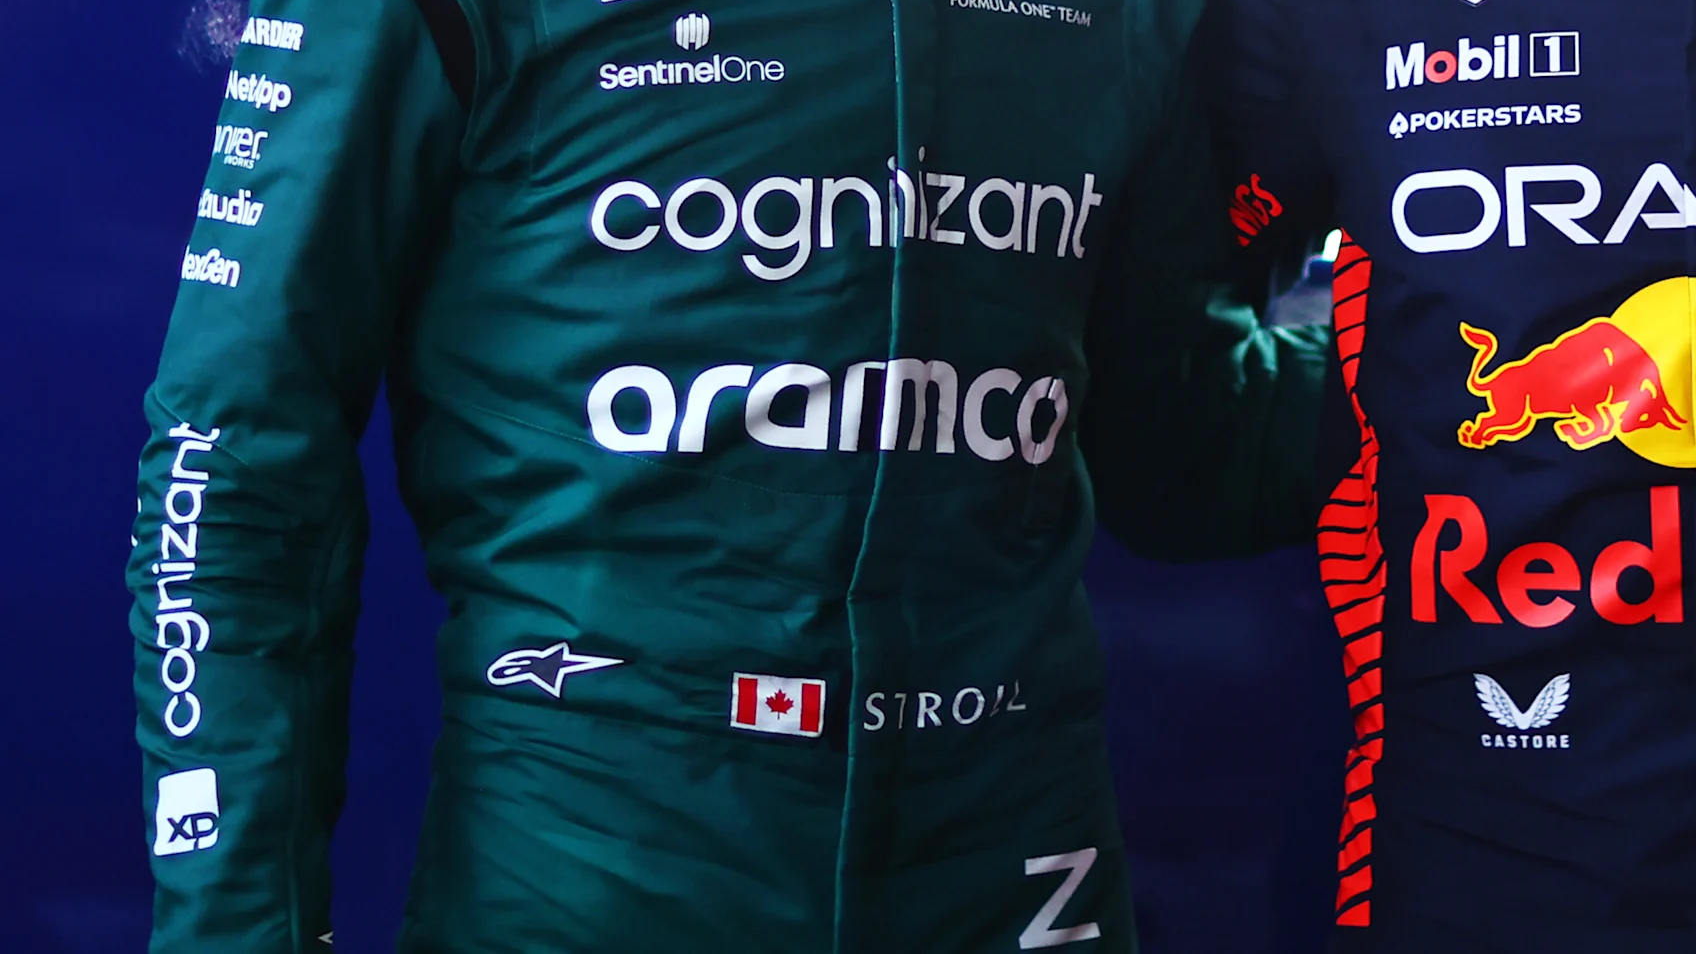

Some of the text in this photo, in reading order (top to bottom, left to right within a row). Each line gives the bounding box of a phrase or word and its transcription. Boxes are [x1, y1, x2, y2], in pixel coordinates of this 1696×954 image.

[240, 16, 304, 51] ARDIER
[1057, 6, 1092, 27] TEAM
[599, 54, 786, 90] SentinelOne
[1386, 34, 1520, 91] Mobil
[1409, 104, 1582, 133] POKERSTARS
[590, 145, 1104, 282] cognizant
[586, 356, 1070, 466] aramco
[1410, 485, 1685, 629] Red
[155, 421, 221, 738] cognizant
[1481, 734, 1571, 749] CASTORE
[166, 811, 219, 850] XP
